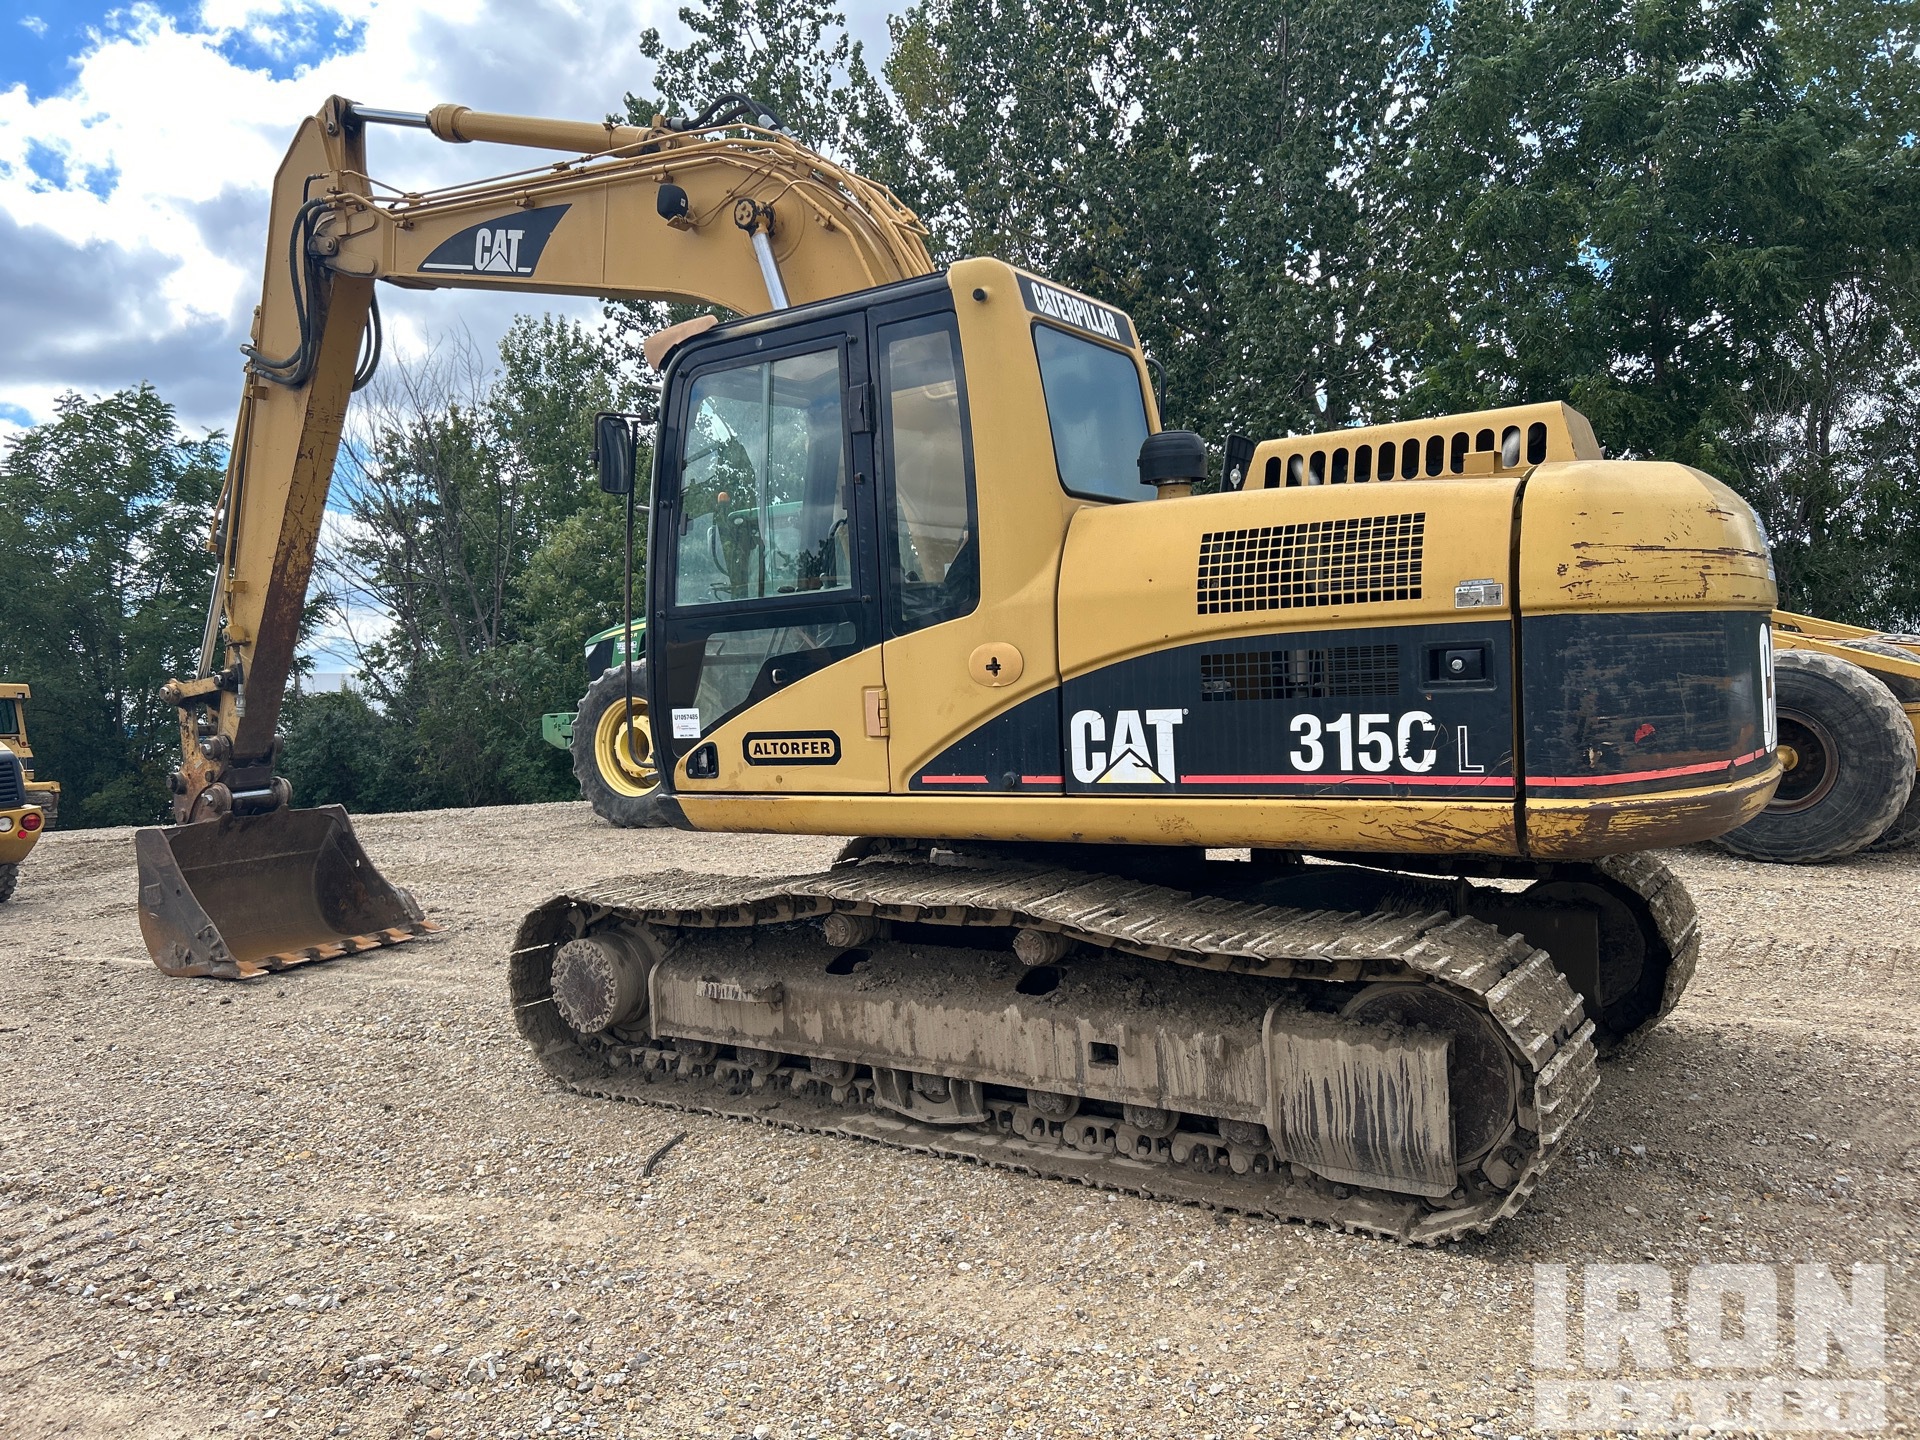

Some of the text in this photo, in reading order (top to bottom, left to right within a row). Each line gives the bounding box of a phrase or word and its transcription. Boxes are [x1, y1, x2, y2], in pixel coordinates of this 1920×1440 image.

[474, 227, 524, 272] CAT
[1030, 281, 1120, 340] CATERPILLAR
[753, 741, 831, 755] ALTORFER
[1070, 708, 1183, 784] CAT
[1289, 710, 1485, 774] 315C L
